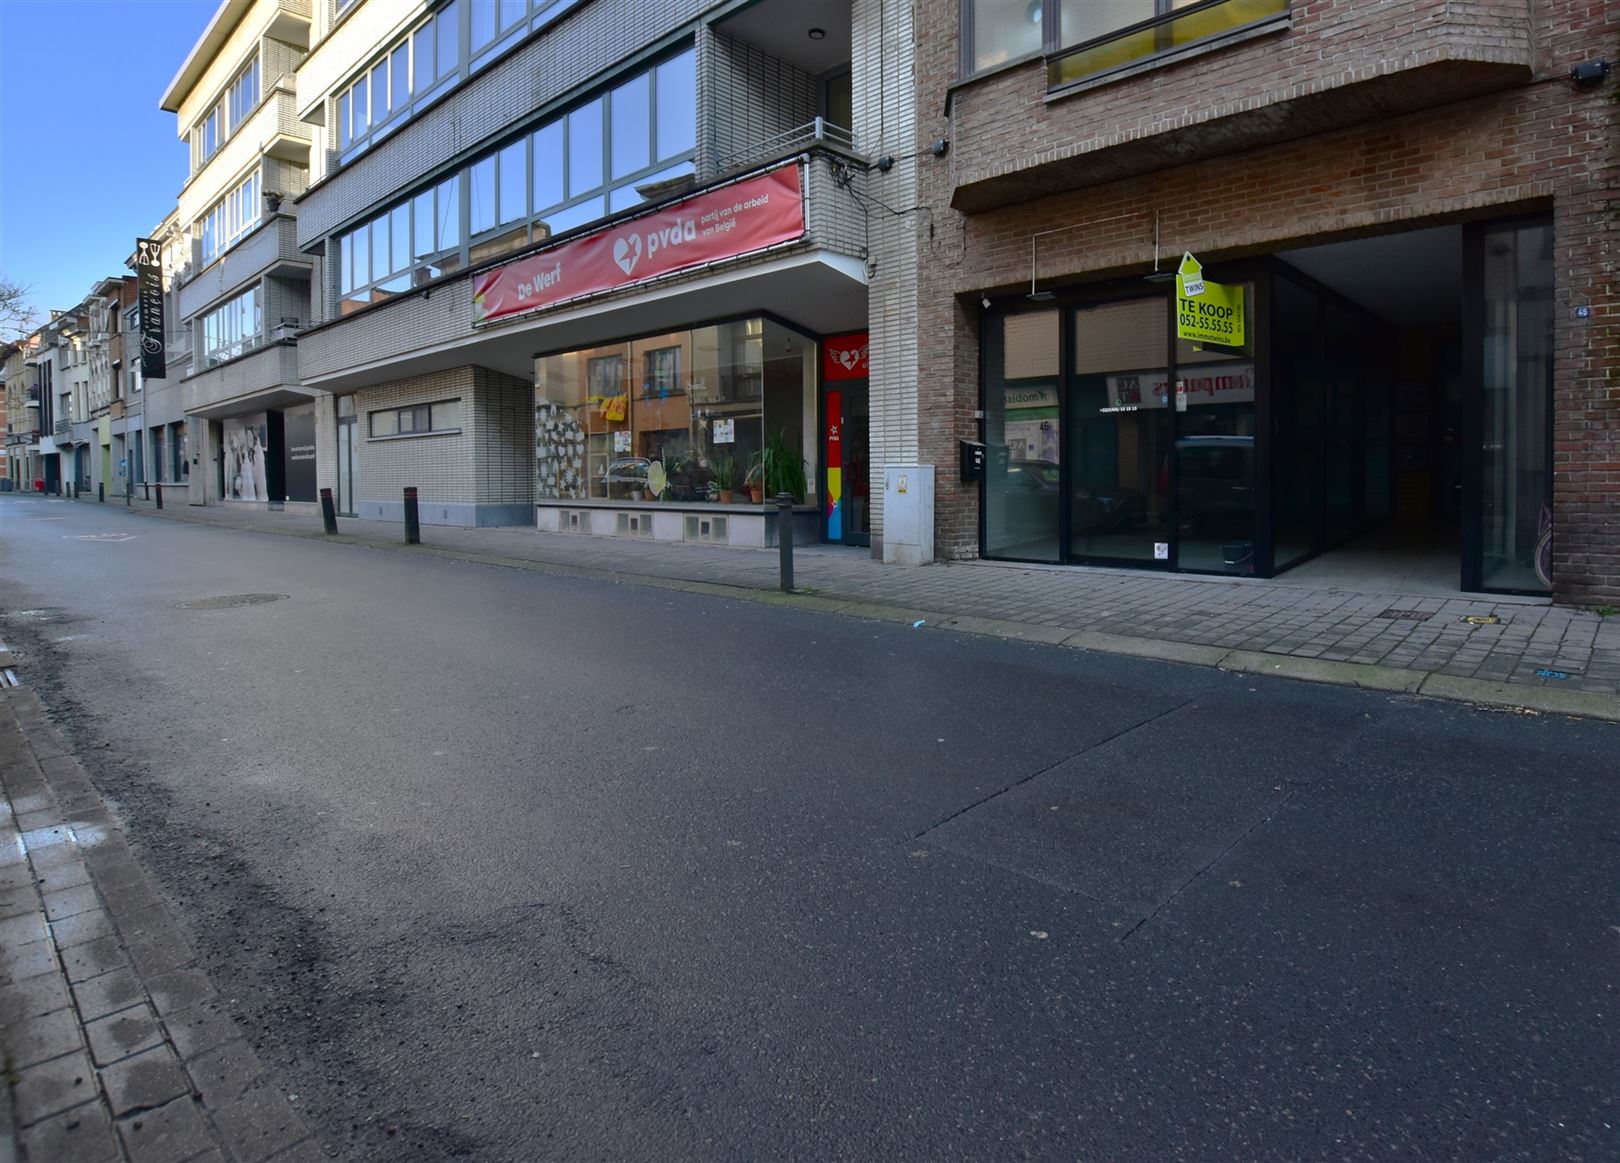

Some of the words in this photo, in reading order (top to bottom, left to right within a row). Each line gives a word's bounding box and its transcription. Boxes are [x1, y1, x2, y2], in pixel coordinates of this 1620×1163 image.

[701, 209, 719, 225] partij
[719, 207, 732, 217] van
[733, 203, 743, 212] de
[744, 194, 769, 209] arbeid
[647, 217, 696, 260] pvda
[703, 227, 715, 236] van
[715, 218, 736, 232] België
[518, 283, 532, 301] De
[533, 262, 561, 292] Werf
[1185, 282, 1204, 294] TWINS
[142, 273, 162, 354] François
[1179, 298, 1195, 313] TE
[1198, 302, 1233, 320] KOOP
[1180, 313, 1233, 334] 052-55.55.55
